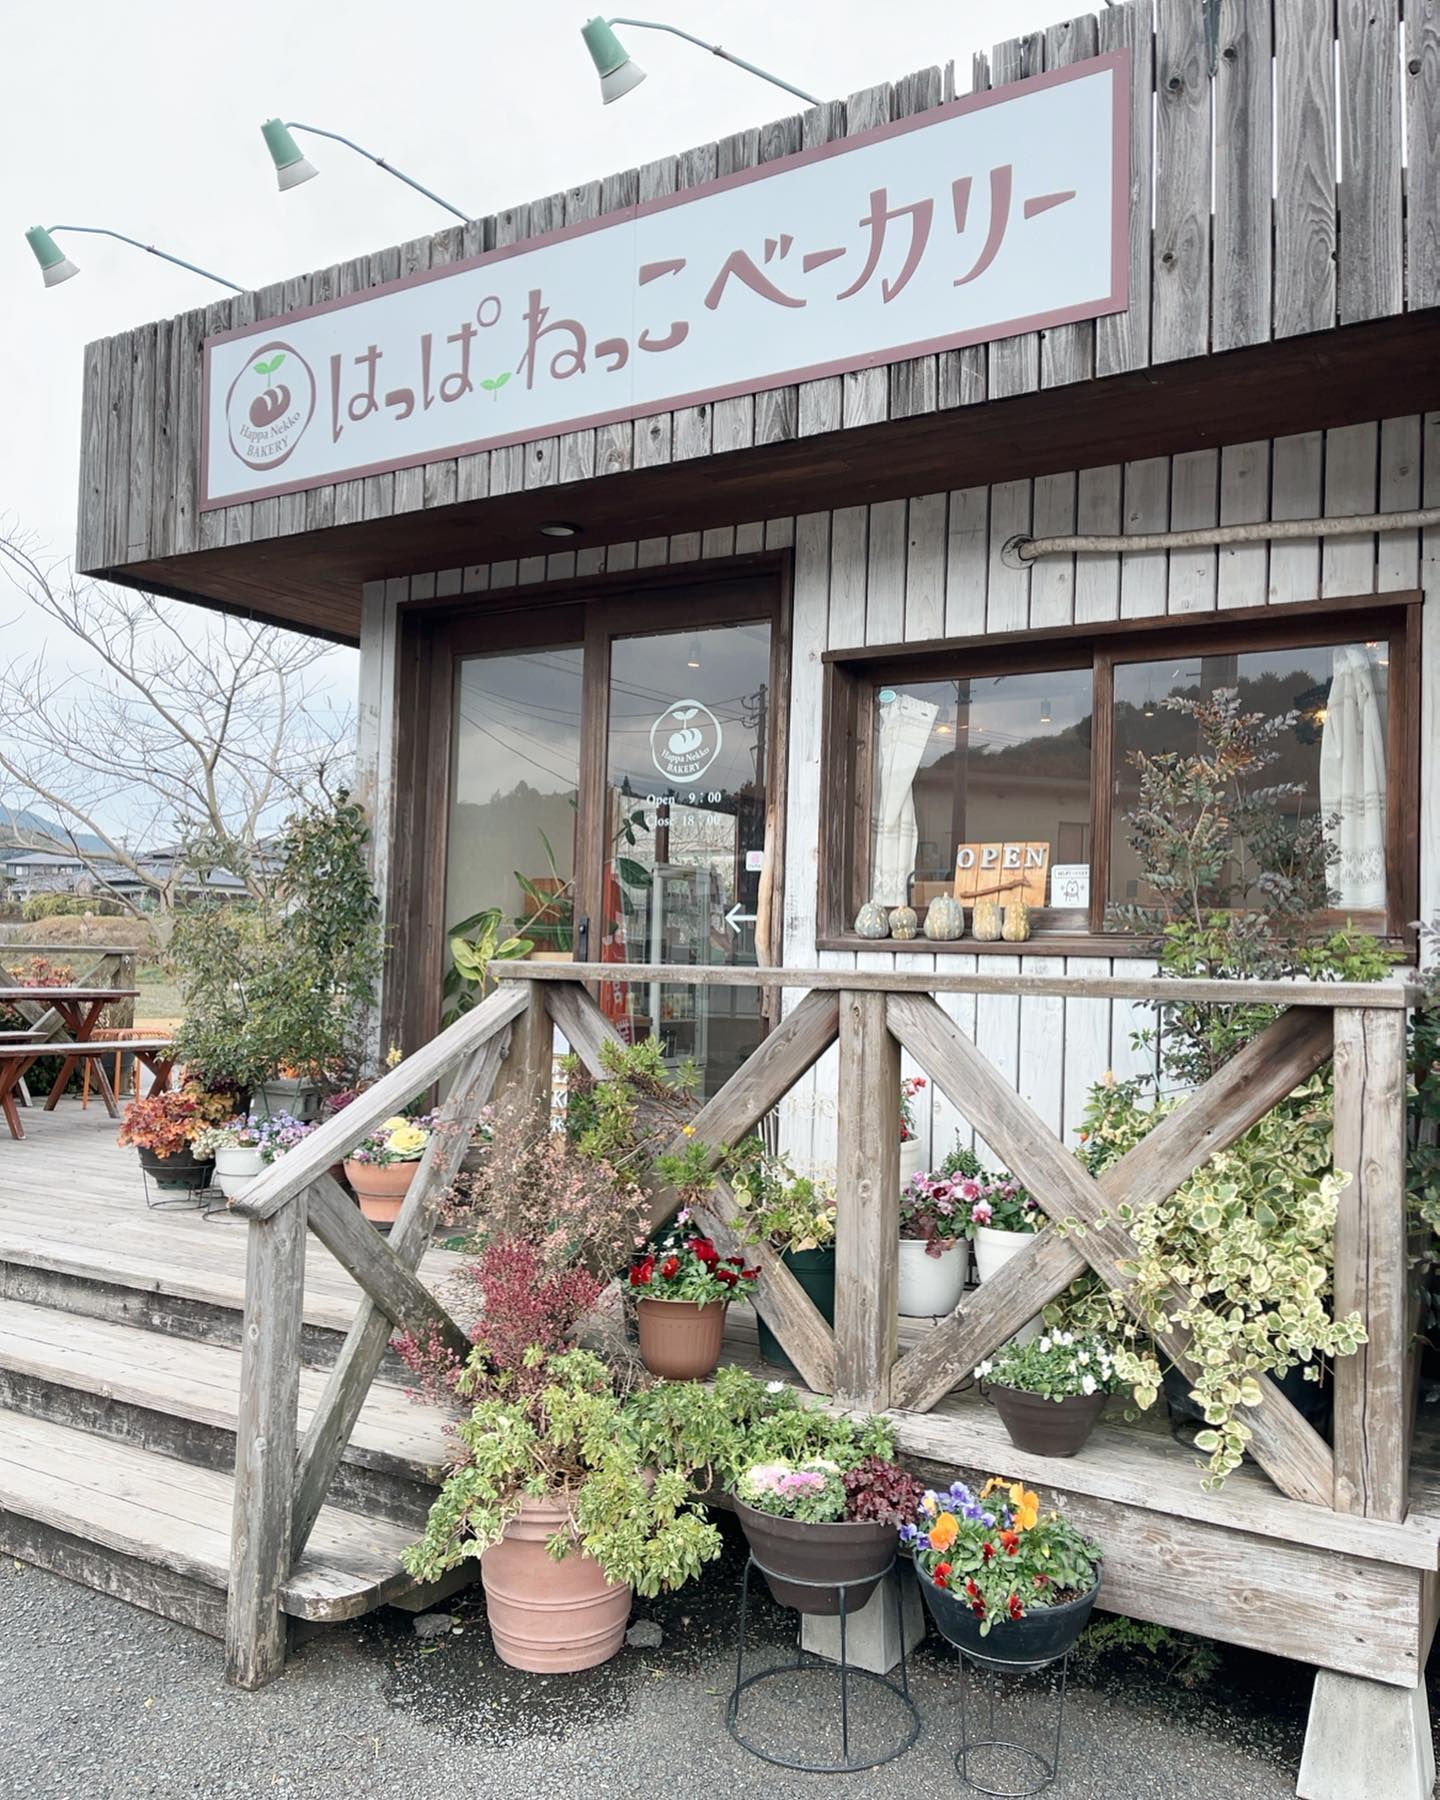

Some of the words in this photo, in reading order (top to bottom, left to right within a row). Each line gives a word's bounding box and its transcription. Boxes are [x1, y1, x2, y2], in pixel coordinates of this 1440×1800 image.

[240, 424, 269, 443] Happa
[271, 412, 301, 438] Nekko
[247, 435, 288, 457] BAKERY
[661, 749, 684, 764] Happa
[686, 747, 710, 762] Nekko
[667, 762, 700, 773] BAKERY
[646, 794, 675, 808] Open
[957, 848, 1047, 869] OPEN
